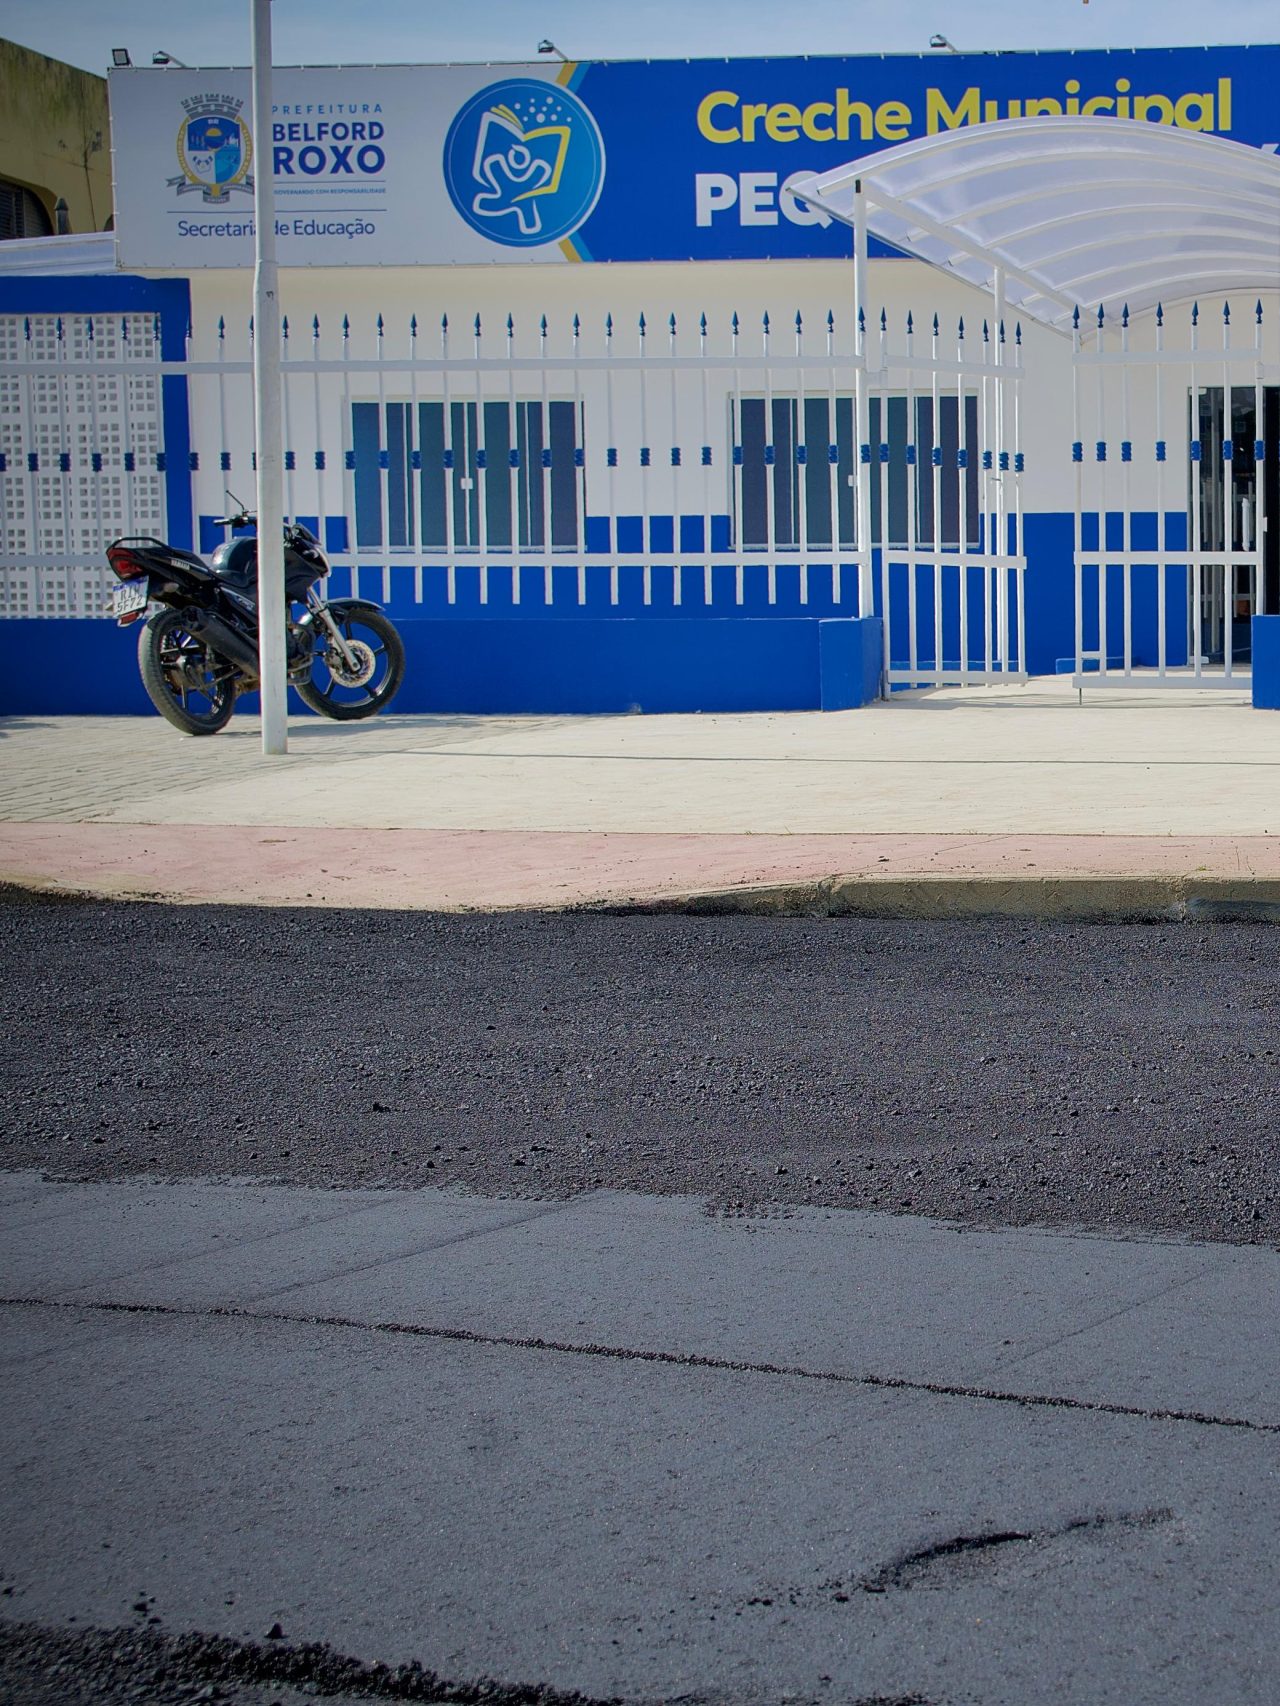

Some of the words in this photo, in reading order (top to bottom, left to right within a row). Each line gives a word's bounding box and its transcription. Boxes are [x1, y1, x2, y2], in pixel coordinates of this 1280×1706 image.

[272, 103, 383, 115] PREFEITURA
[697, 88, 912, 143] Creche
[272, 121, 385, 142] BELFORD
[273, 144, 386, 175] ROXO
[293, 217, 376, 240] Educação
